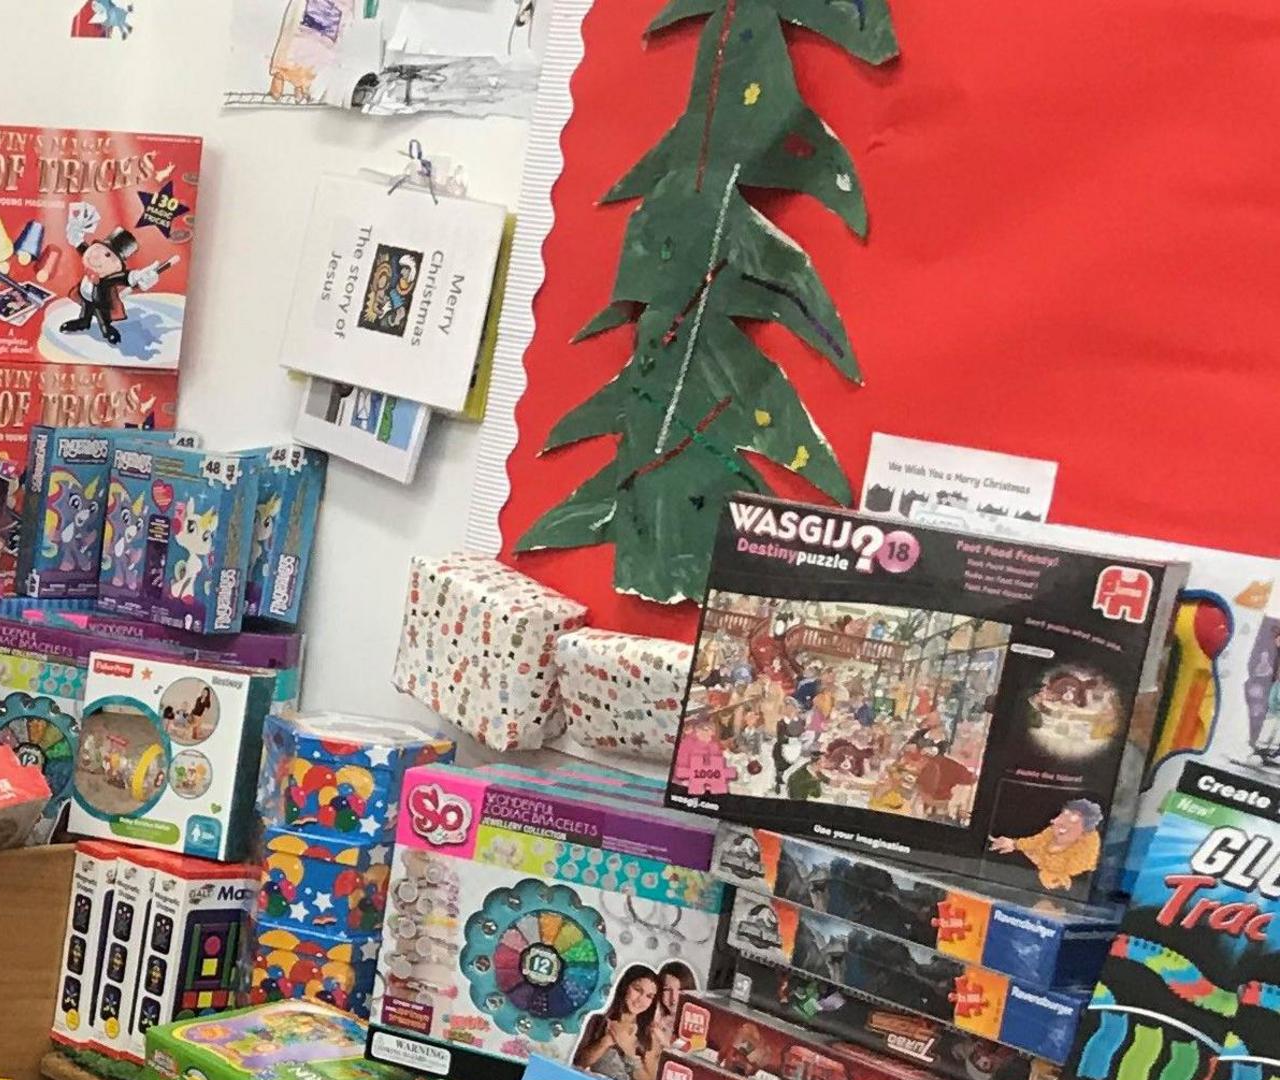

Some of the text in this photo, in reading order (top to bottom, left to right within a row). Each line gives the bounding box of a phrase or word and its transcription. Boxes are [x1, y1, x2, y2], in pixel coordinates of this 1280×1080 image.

[354, 224, 374, 260] The
[320, 250, 340, 301] Jesus
[342, 263, 366, 317] story
[411, 250, 445, 348] Christmas
[441, 274, 466, 337] Merry
[205, 461, 221, 474] 48
[887, 539, 911, 563] 18
[1196, 775, 1272, 809] Create
[855, 831, 911, 854] imagination
[532, 956, 553, 973] 12
